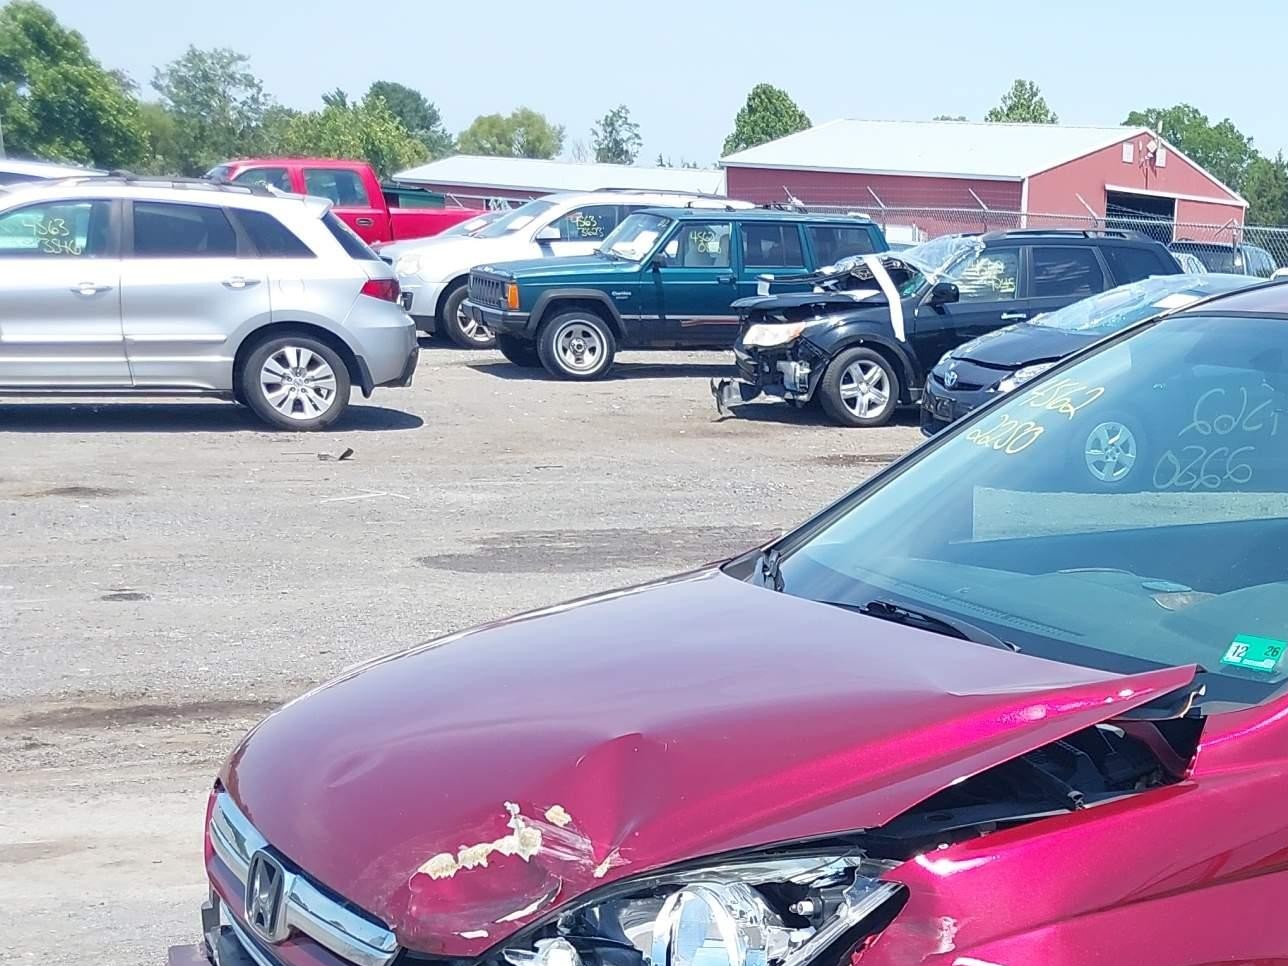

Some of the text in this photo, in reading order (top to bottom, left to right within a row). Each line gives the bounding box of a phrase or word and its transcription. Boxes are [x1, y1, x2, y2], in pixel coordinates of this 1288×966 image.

[22, 218, 70, 237] 4563
[1232, 644, 1281, 658] 12 26
